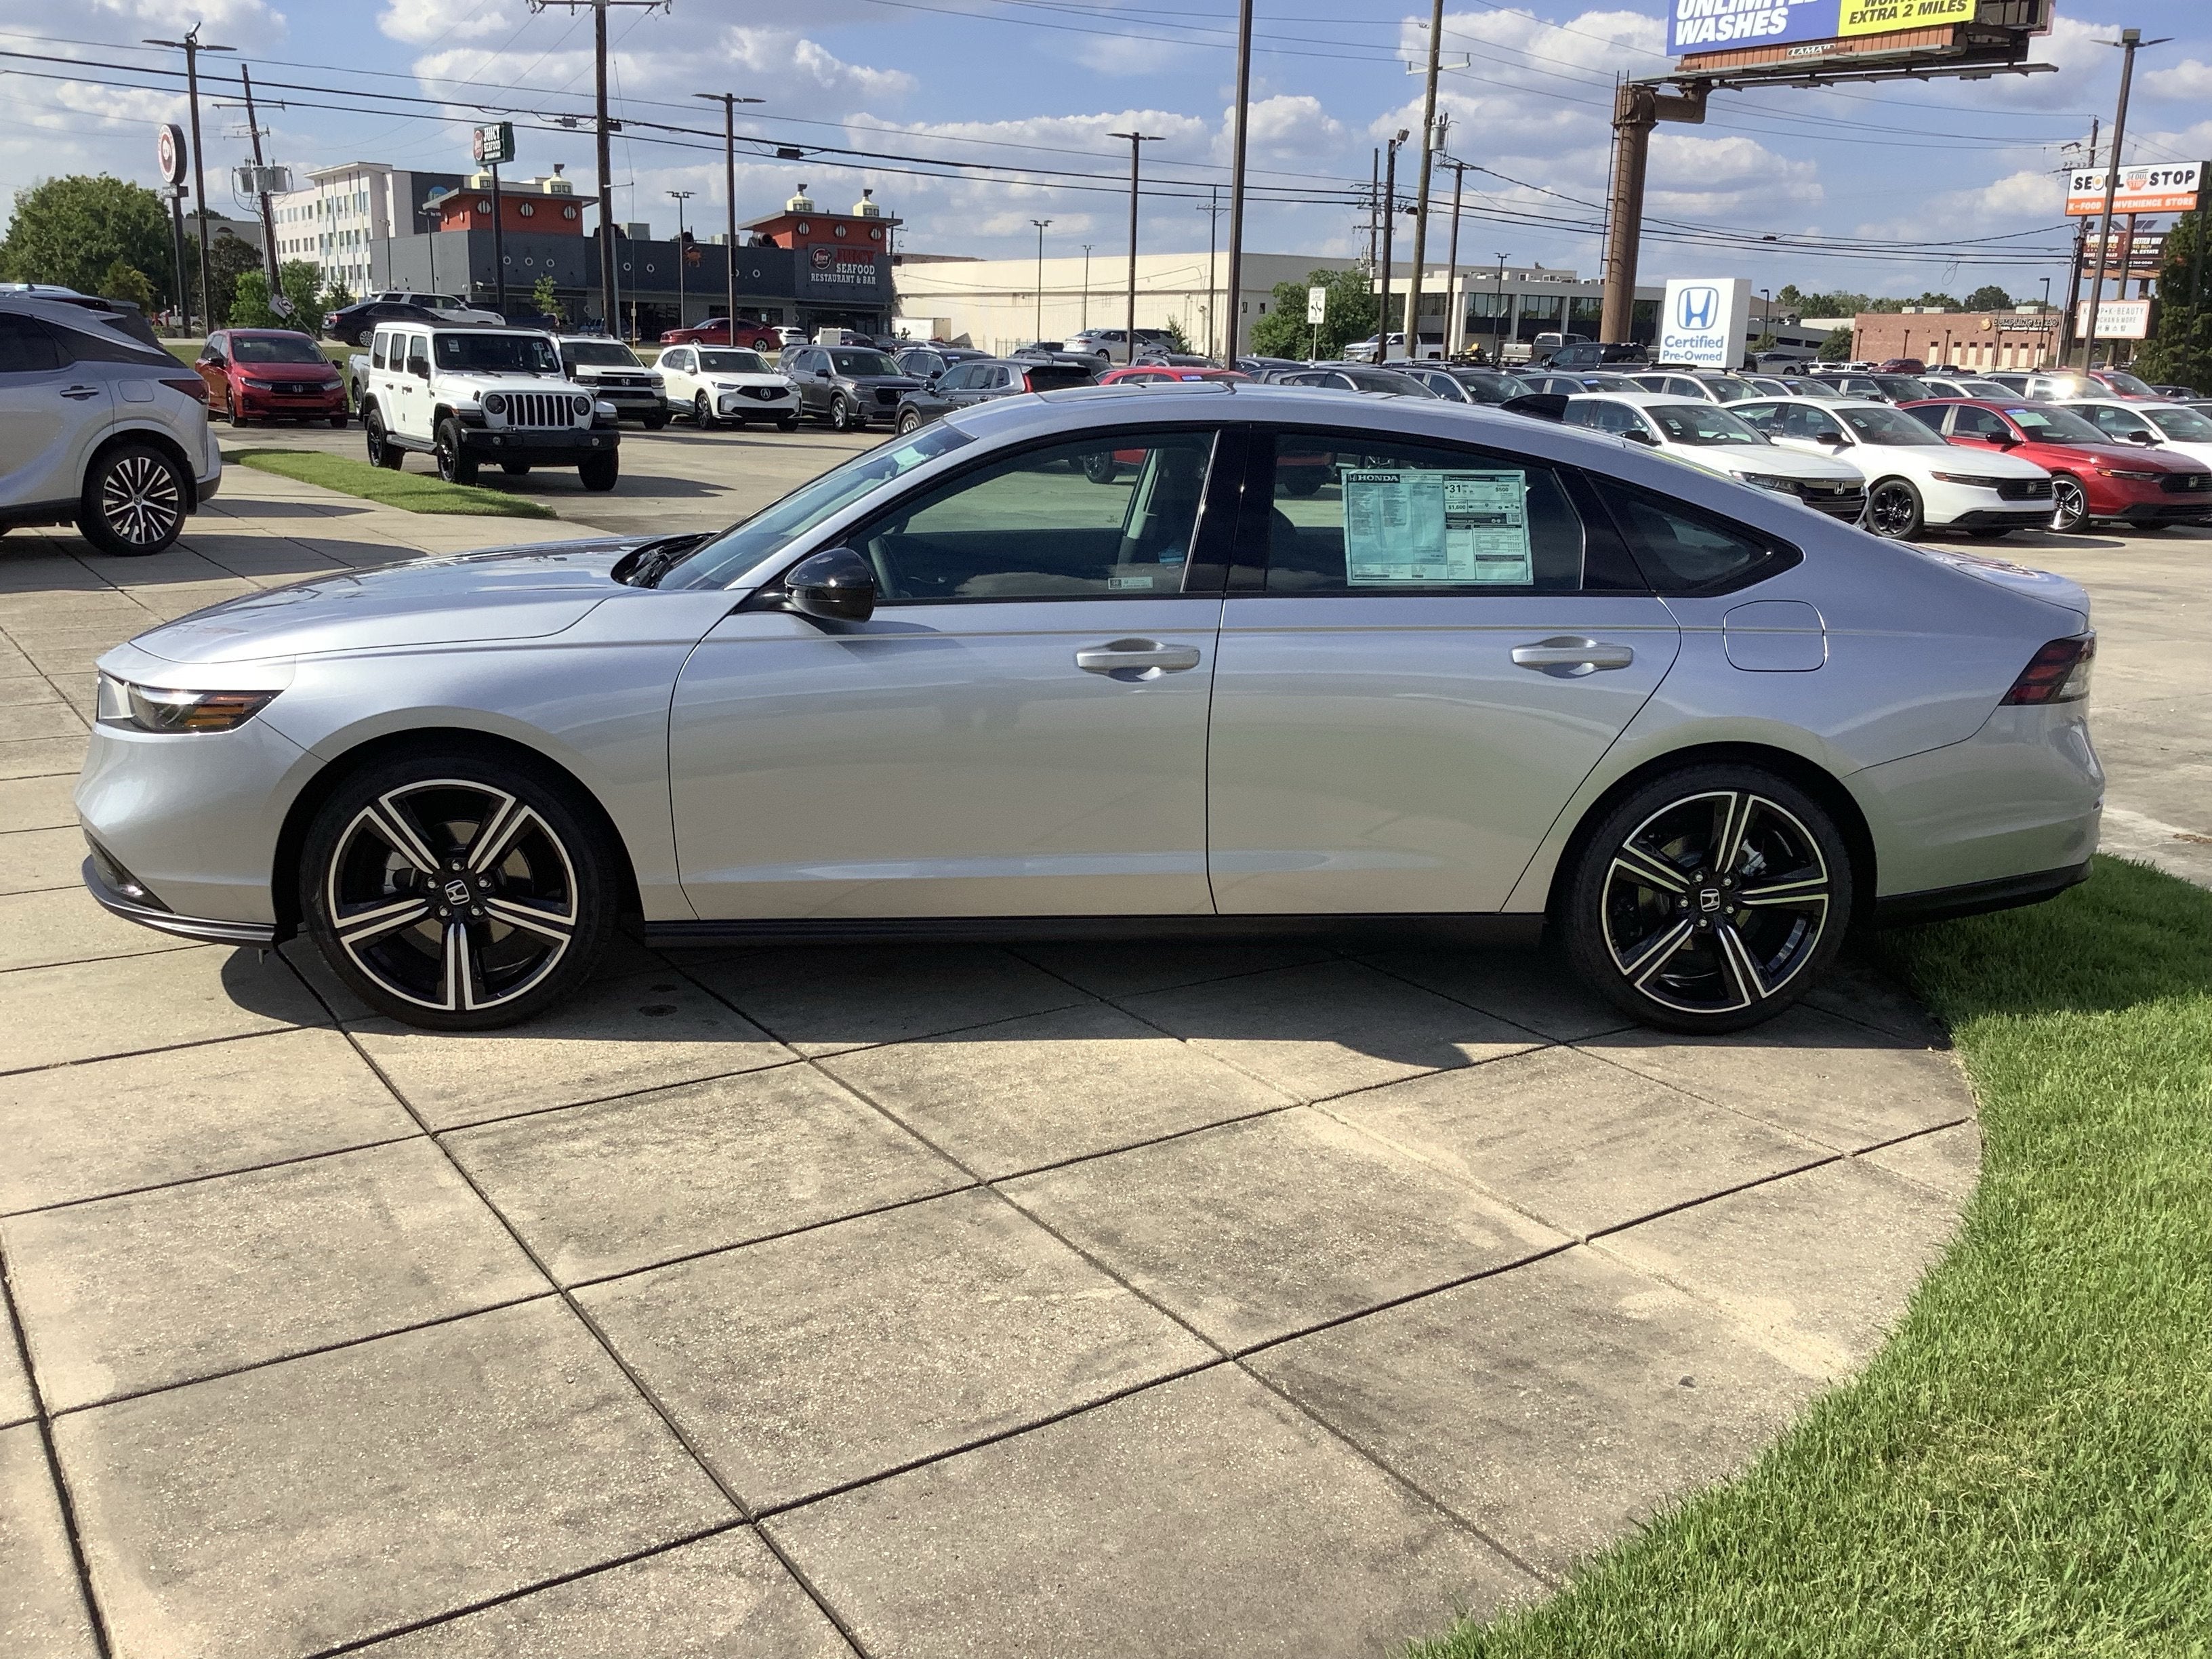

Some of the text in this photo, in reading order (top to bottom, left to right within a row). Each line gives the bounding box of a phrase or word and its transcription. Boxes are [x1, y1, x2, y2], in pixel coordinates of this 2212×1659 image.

[1849, 8, 1898, 24] EXTRA
[1902, 4, 1914, 17] 2
[1917, 0, 1967, 16] MILES
[1675, 8, 1788, 45] WASHES
[483, 125, 500, 142] JUICY
[2149, 170, 2195, 186] STOP
[2068, 197, 2194, 211] K-FOOD NVENIENCE STORE
[836, 263, 875, 275] SEAFOOD
[811, 273, 876, 285] RESTAURANT & BAR
[1993, 318, 2033, 327] DUMPLING
[1664, 335, 1724, 348] Certified
[1662, 350, 1723, 361] Pre-Owned
[1449, 484, 1461, 493] 31
